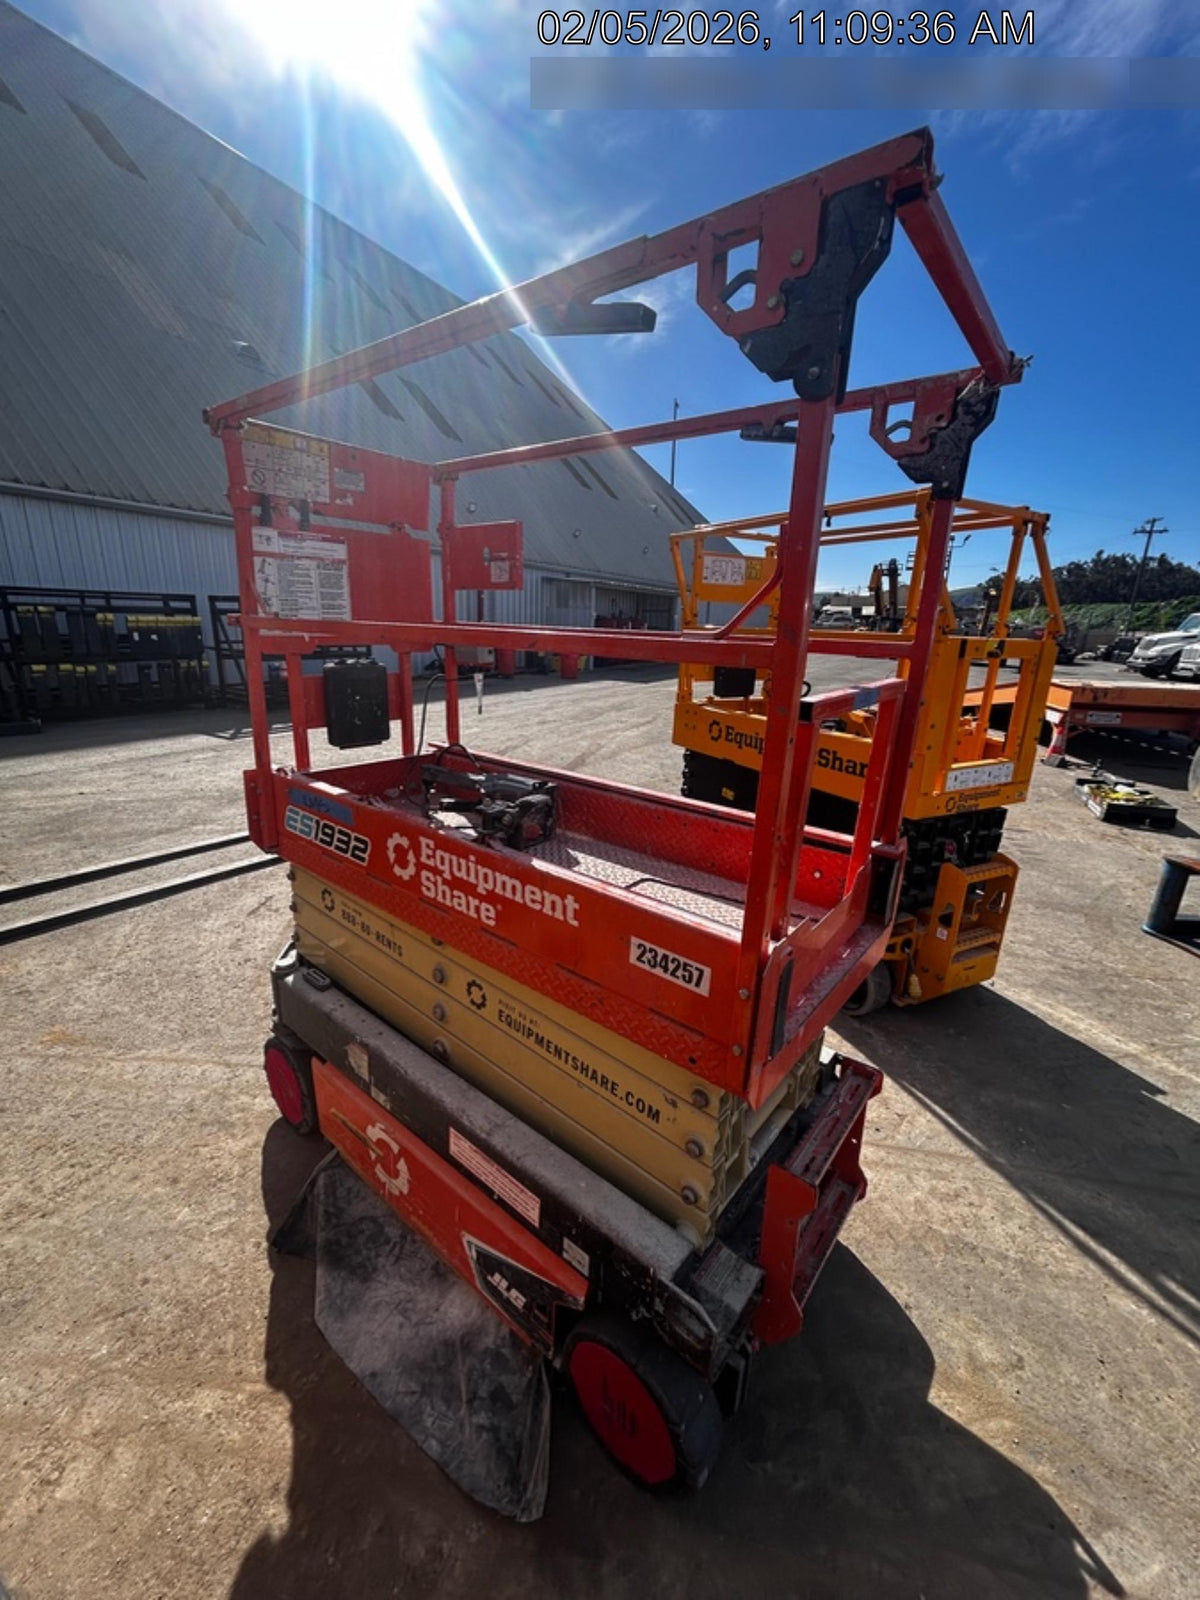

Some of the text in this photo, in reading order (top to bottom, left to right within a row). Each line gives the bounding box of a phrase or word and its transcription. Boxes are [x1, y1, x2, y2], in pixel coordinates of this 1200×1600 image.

[817, 747, 869, 778] Shar
[285, 807, 370, 865] ES1932
[418, 836, 580, 928] Equipment
[420, 872, 497, 928] Share
[636, 943, 705, 988] 234257
[498, 1009, 661, 1125] EQUIPMENTSHARE.COM
